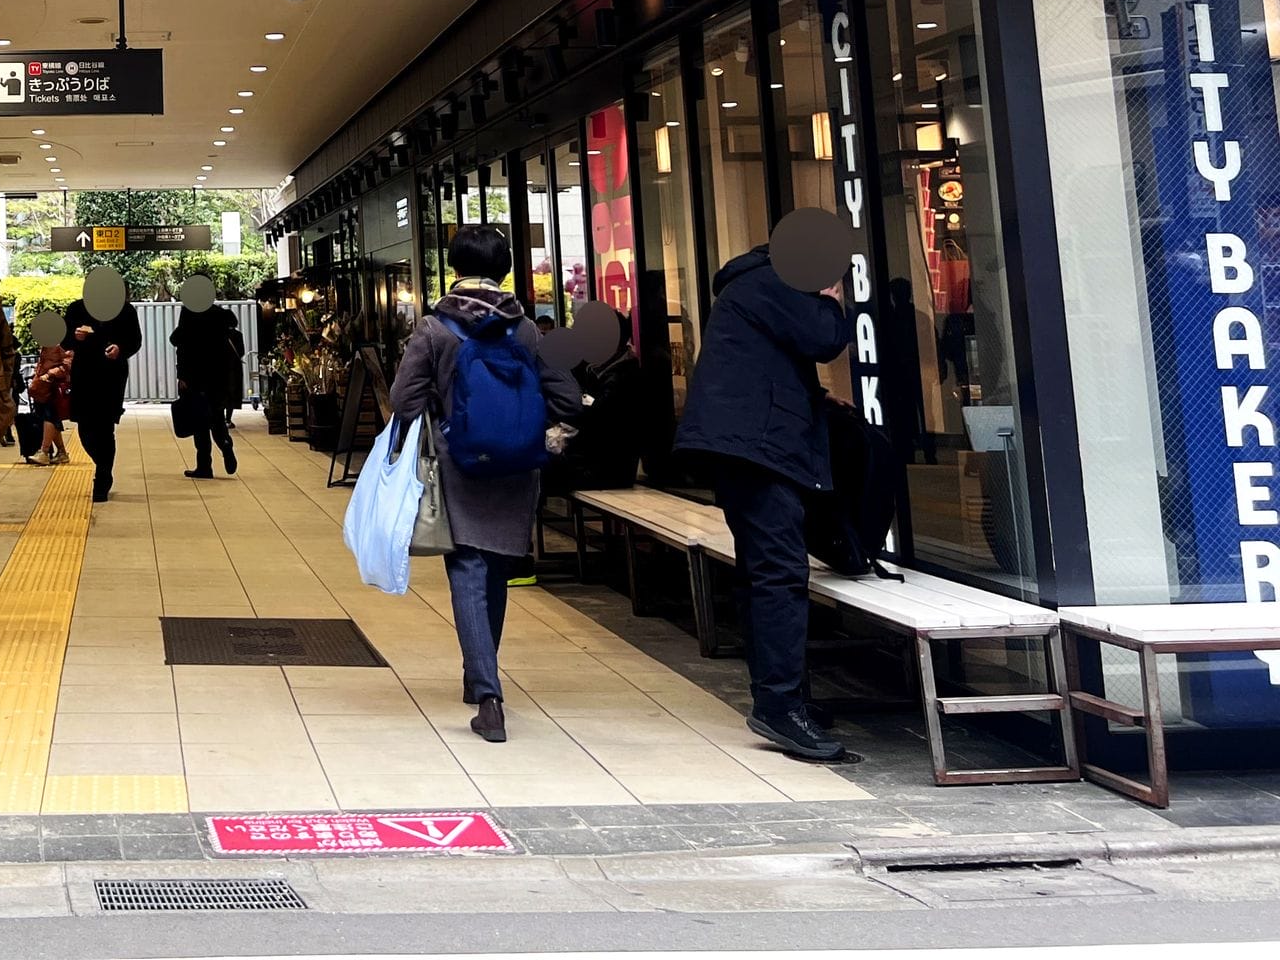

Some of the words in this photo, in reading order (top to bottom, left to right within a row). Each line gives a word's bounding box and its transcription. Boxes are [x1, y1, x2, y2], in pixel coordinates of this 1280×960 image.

[28, 76, 111, 92] きっぷうりば
[29, 94, 60, 103] Tickets
[831, 10, 862, 228] CITY
